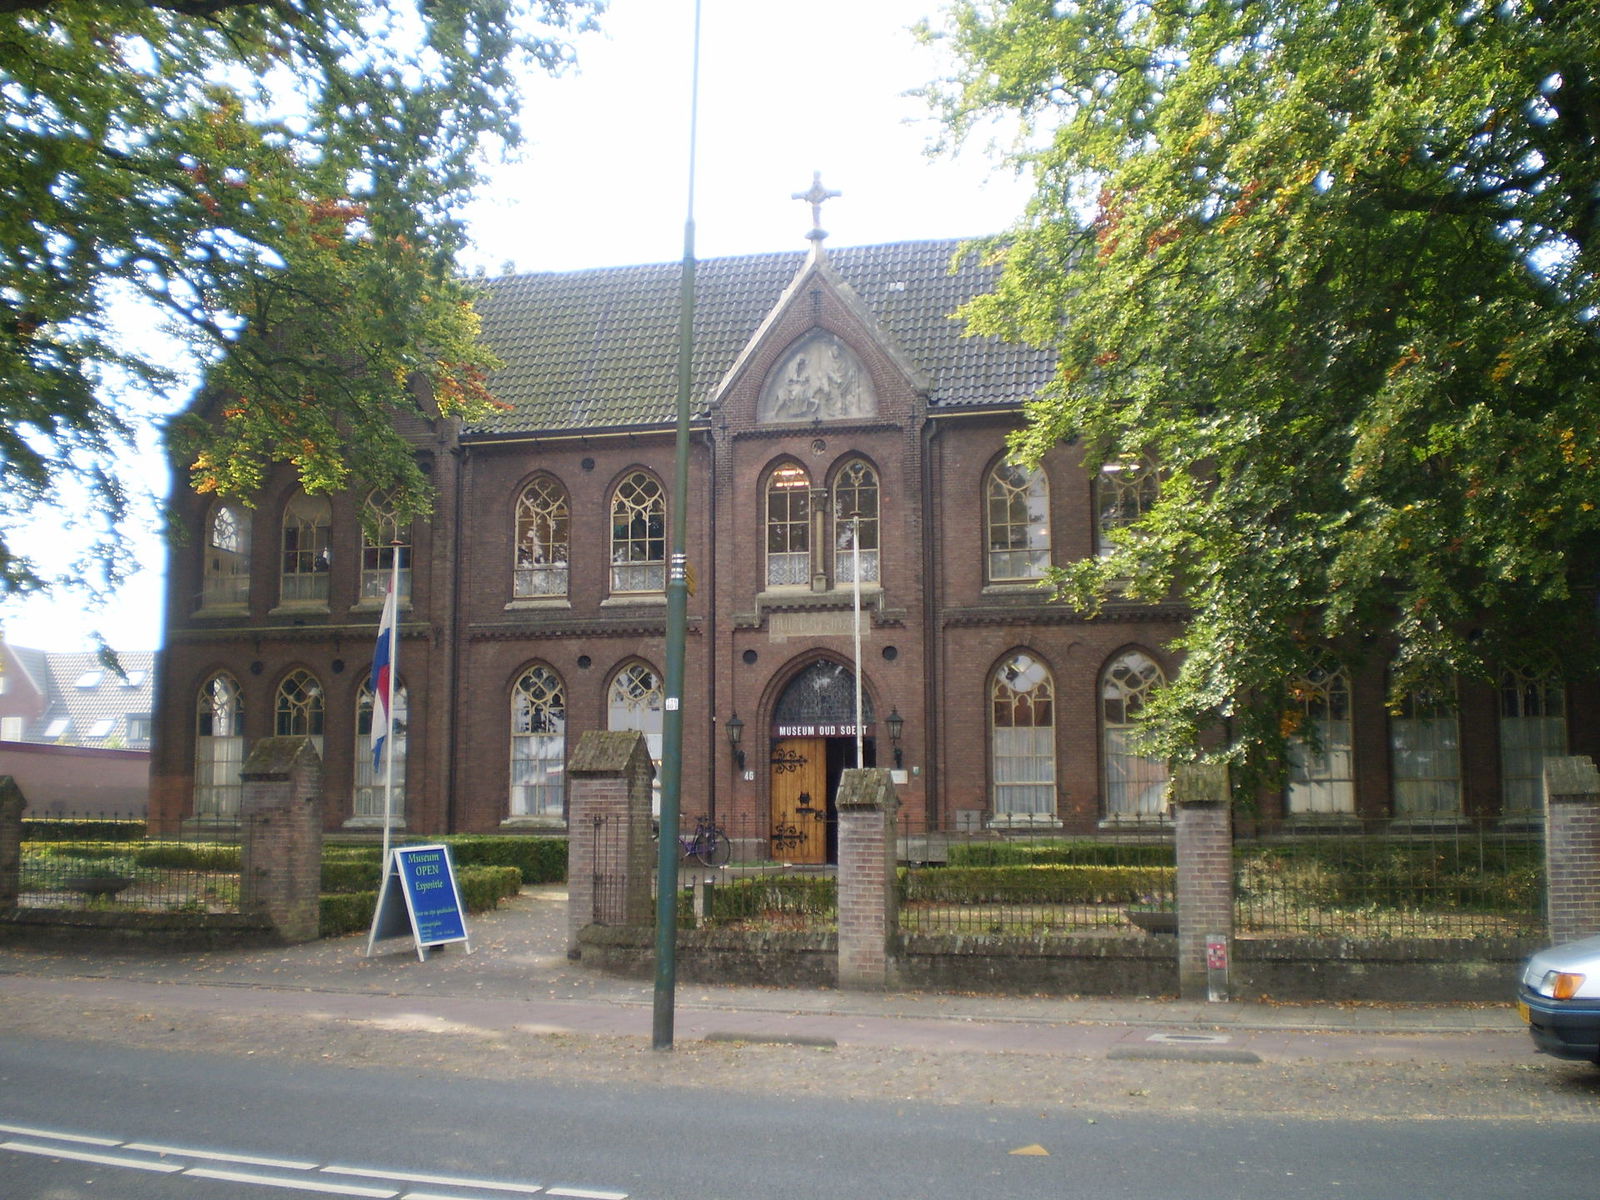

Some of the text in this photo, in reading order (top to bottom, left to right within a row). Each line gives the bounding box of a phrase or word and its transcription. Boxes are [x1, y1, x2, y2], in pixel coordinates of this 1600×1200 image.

[779, 725, 868, 736] MUSEUM OUD SOET
[744, 770, 754, 781] 46
[408, 853, 440, 864] Museum
[415, 864, 439, 876] OPEN
[415, 880, 443, 894] Expositie
